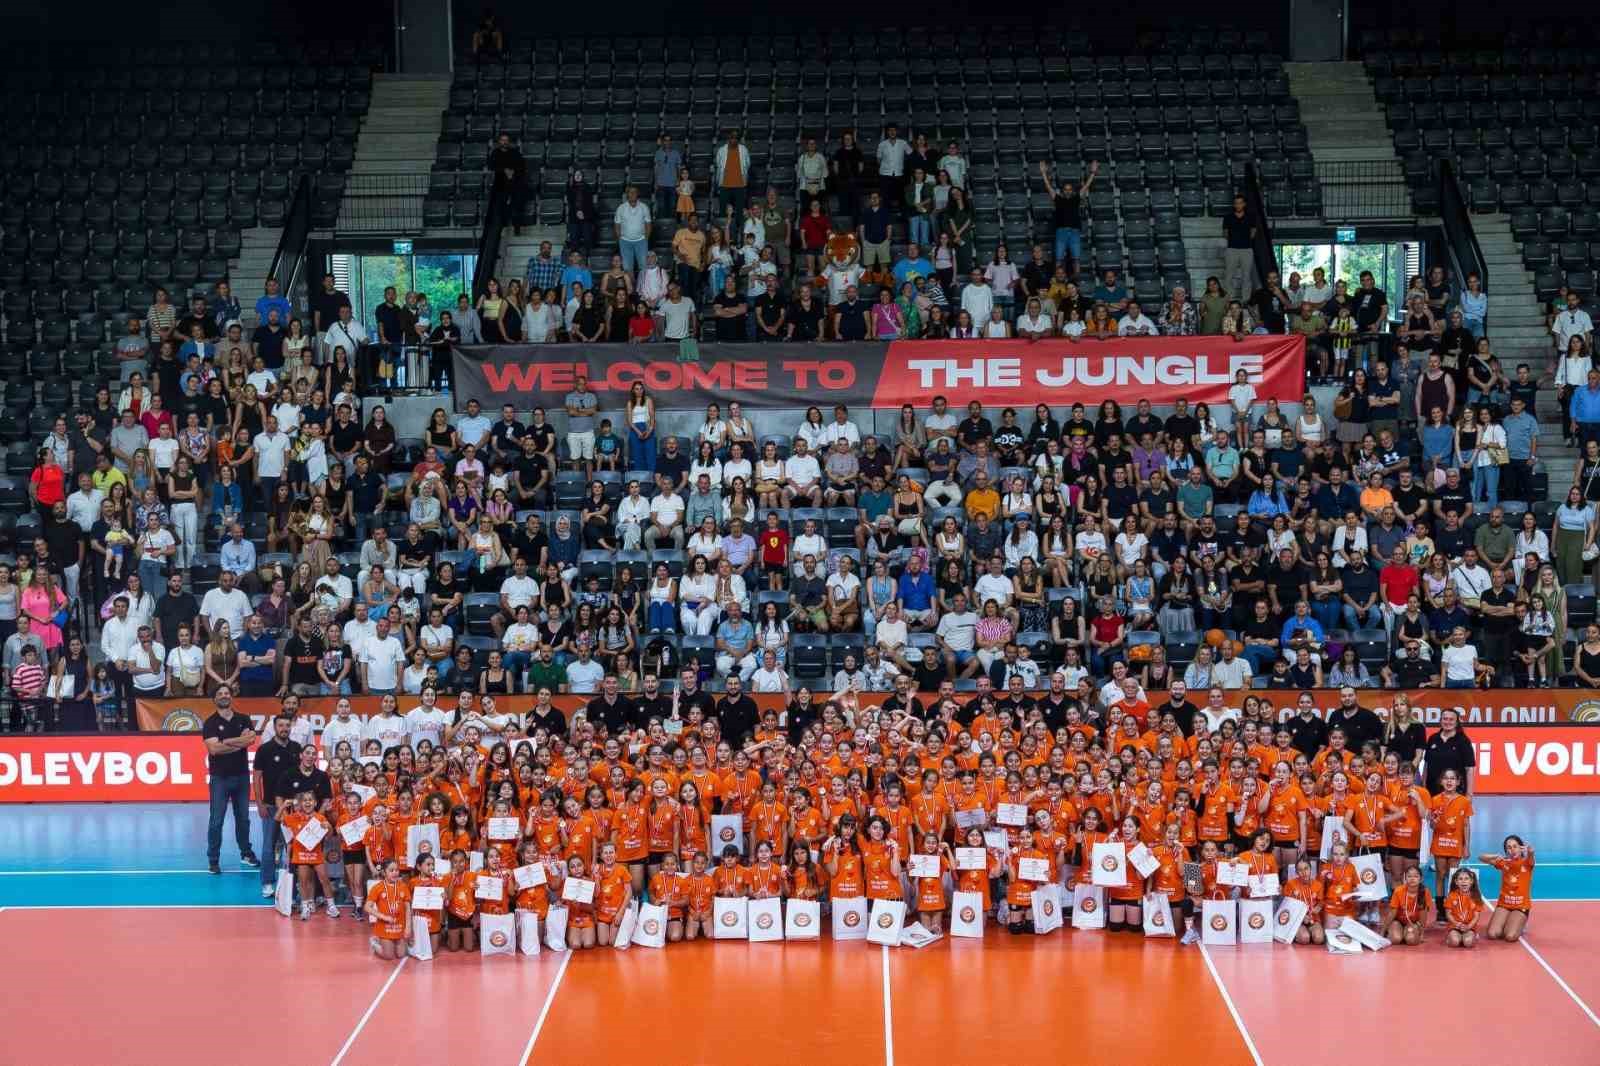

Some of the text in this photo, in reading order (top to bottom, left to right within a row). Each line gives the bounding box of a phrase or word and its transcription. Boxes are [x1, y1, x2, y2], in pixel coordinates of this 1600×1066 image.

[480, 355, 1264, 392] WELCOME TO THE JUNGLE
[1503, 742, 1600, 776] VOL
